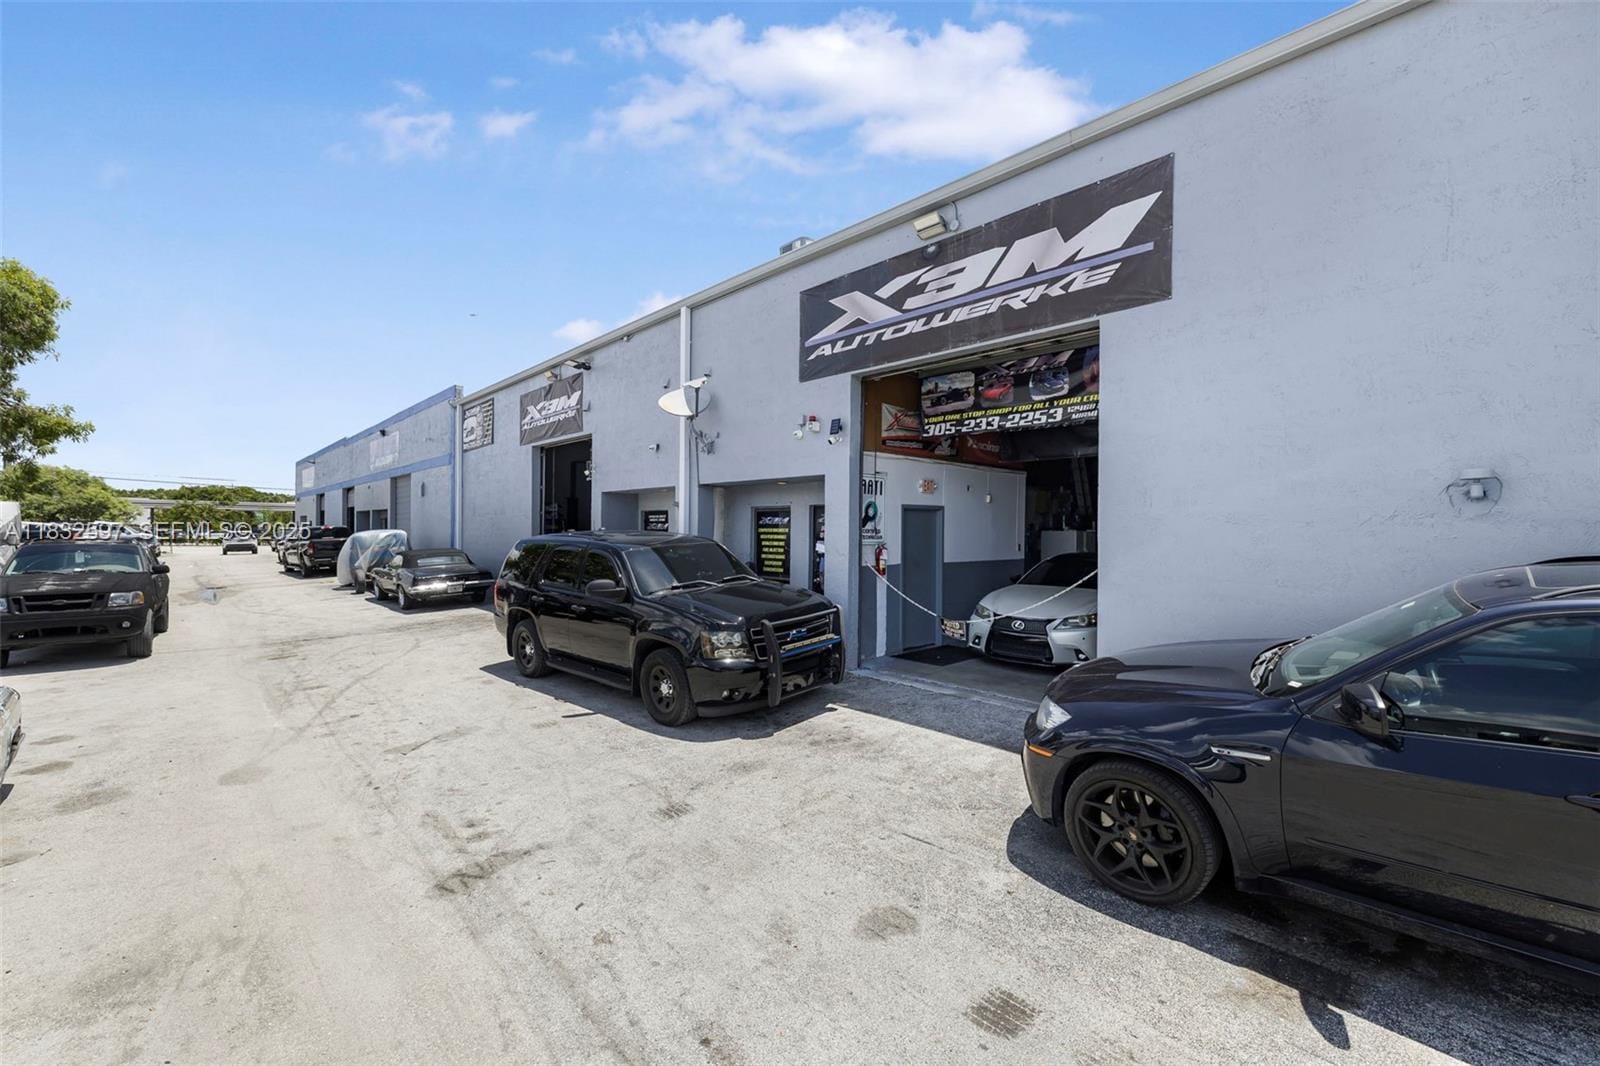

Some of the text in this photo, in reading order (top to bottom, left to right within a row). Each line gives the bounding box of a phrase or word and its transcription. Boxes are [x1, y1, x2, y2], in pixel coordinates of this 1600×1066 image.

[807, 262, 1121, 361] AUTOWERKE
[922, 406, 1064, 437] 305-233-2253
[924, 415, 944, 424] YOUR
[962, 410, 985, 419] STOP
[986, 407, 1012, 416] SHOP
[1012, 404, 1032, 412] FOR
[1032, 401, 1050, 410] ALL
[1053, 396, 1082, 407] YOUR
[1083, 393, 1099, 402] CA
